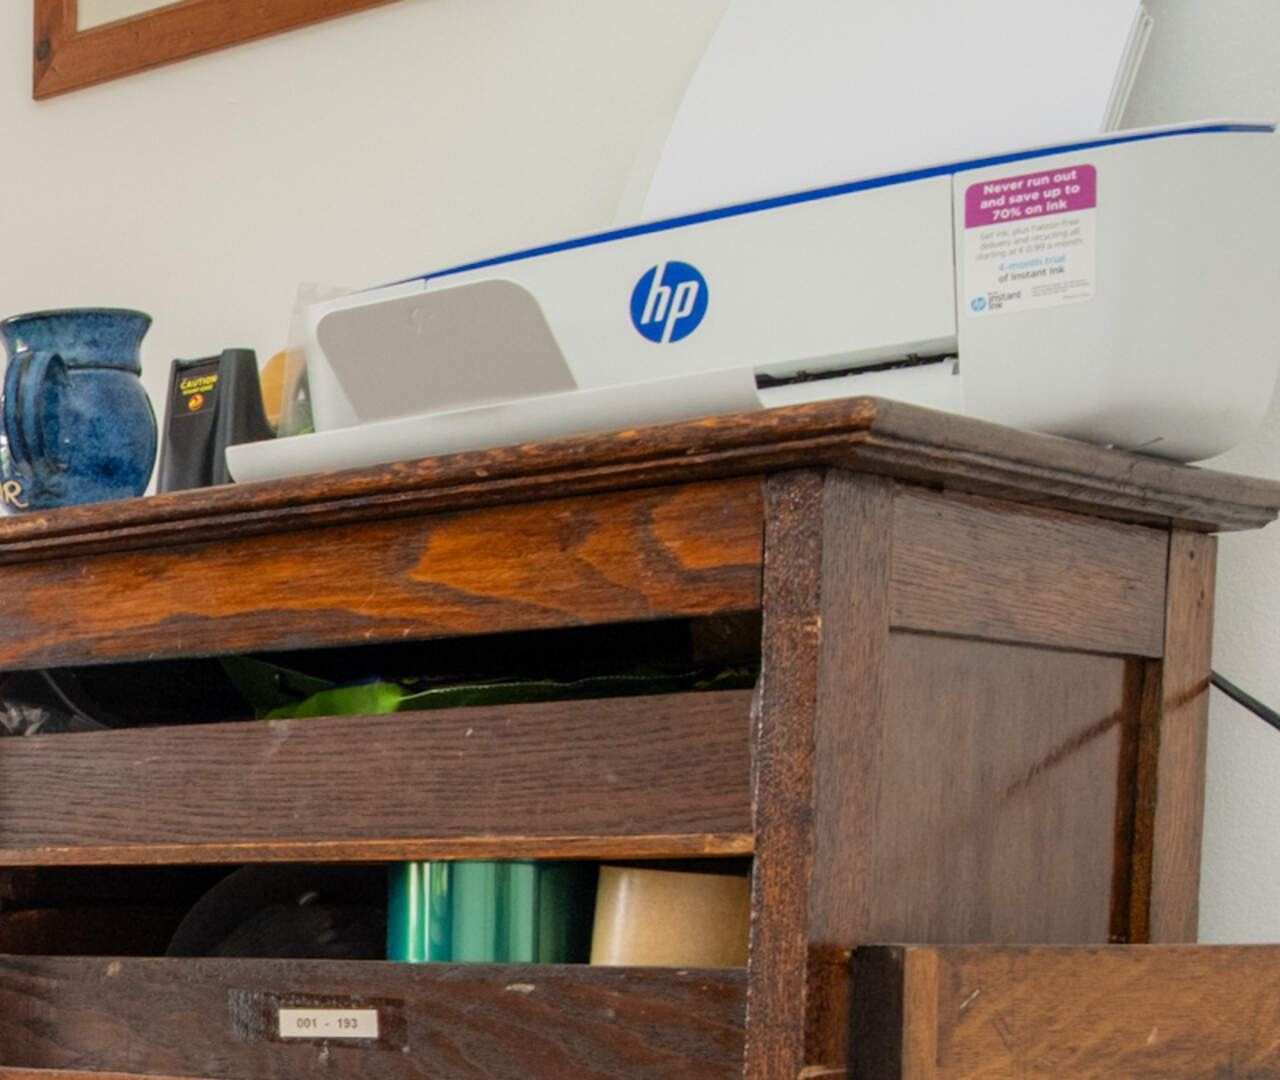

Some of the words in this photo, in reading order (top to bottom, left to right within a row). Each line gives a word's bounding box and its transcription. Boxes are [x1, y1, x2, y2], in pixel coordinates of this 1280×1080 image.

[983, 180, 1023, 195] Never
[1027, 174, 1050, 188] run
[1053, 170, 1077, 183] out
[980, 196, 1005, 209] and
[1008, 191, 1039, 204] save
[1043, 188, 1061, 200] up
[1065, 184, 1081, 195] to
[992, 206, 1021, 221] 70%
[1025, 203, 1043, 215] on
[998, 273, 1009, 283] of
[637, 261, 703, 343] hp
[179, 374, 218, 390] CAUTION
[296, 1017, 317, 1029] 001
[337, 1017, 358, 1029] 193
